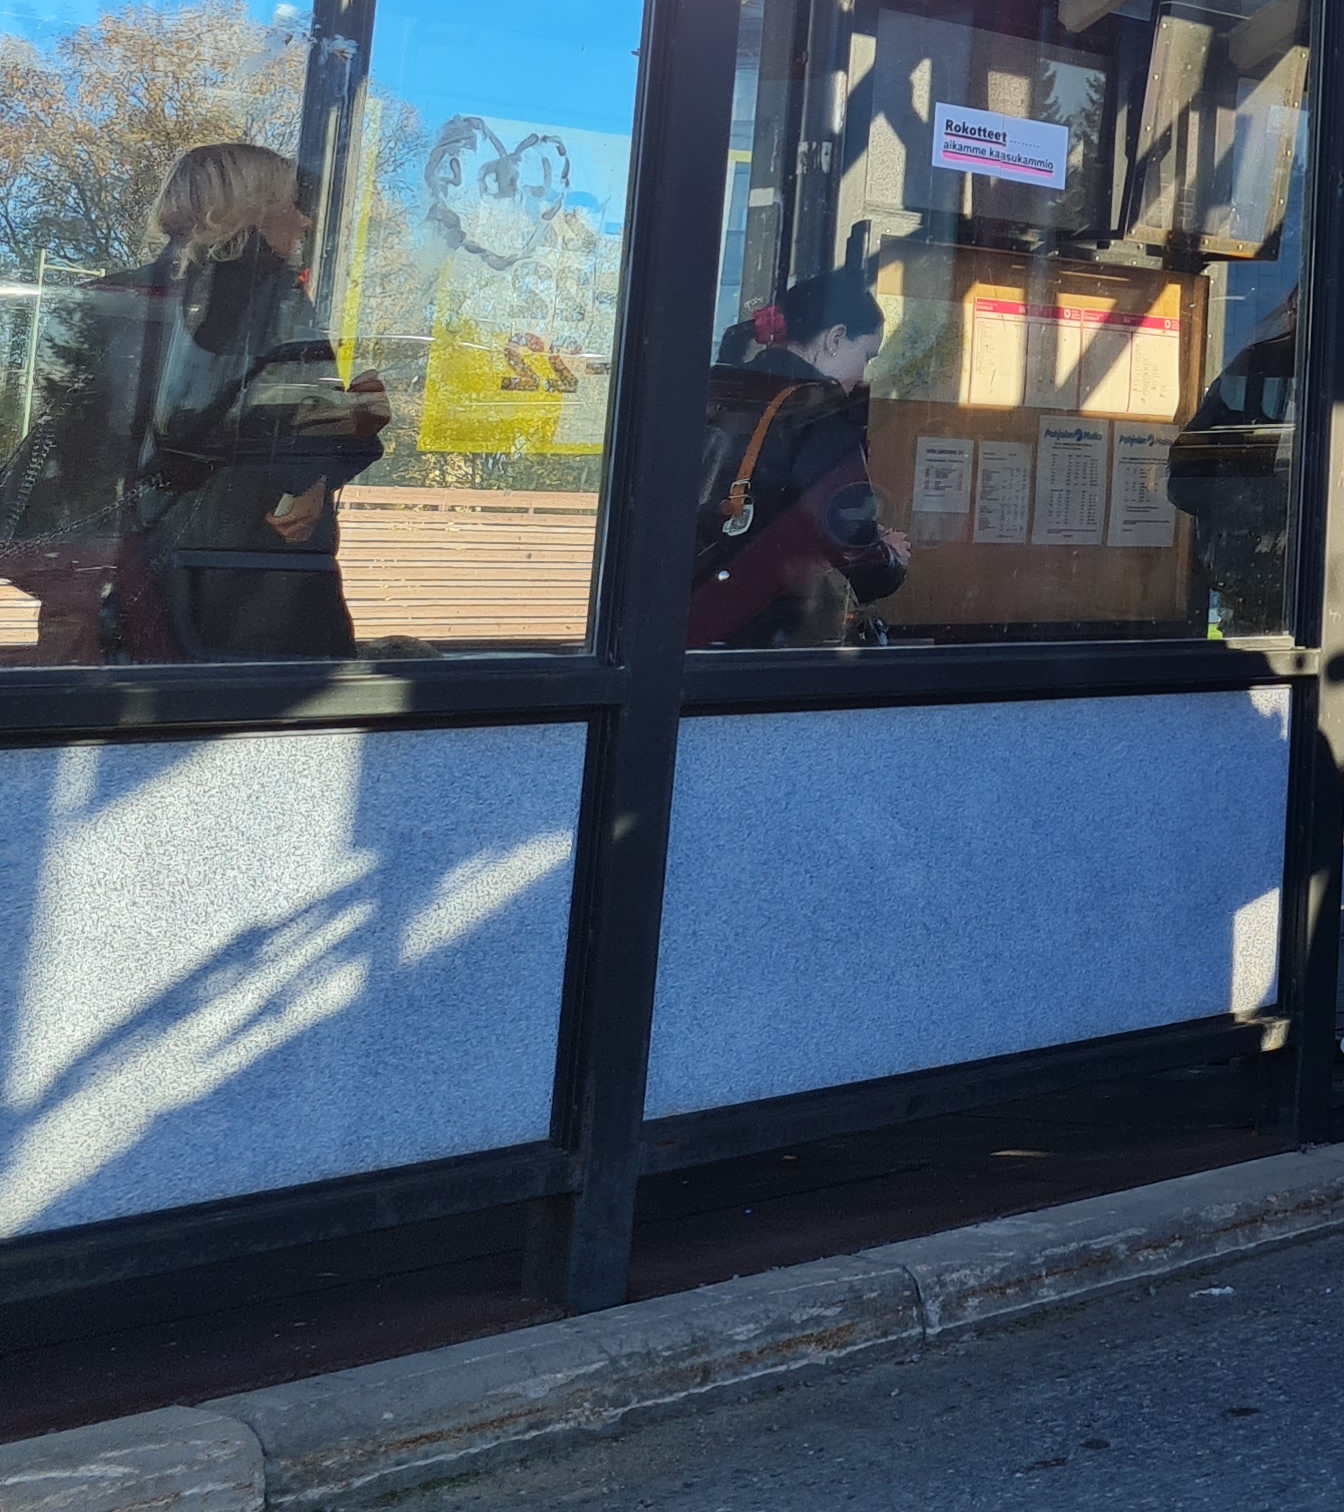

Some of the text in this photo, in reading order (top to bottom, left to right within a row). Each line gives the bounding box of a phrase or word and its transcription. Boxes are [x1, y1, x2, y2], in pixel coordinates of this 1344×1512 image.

[945, 119, 1007, 143] Rokotteet
[943, 140, 1054, 170] aikamme kaasukammio
